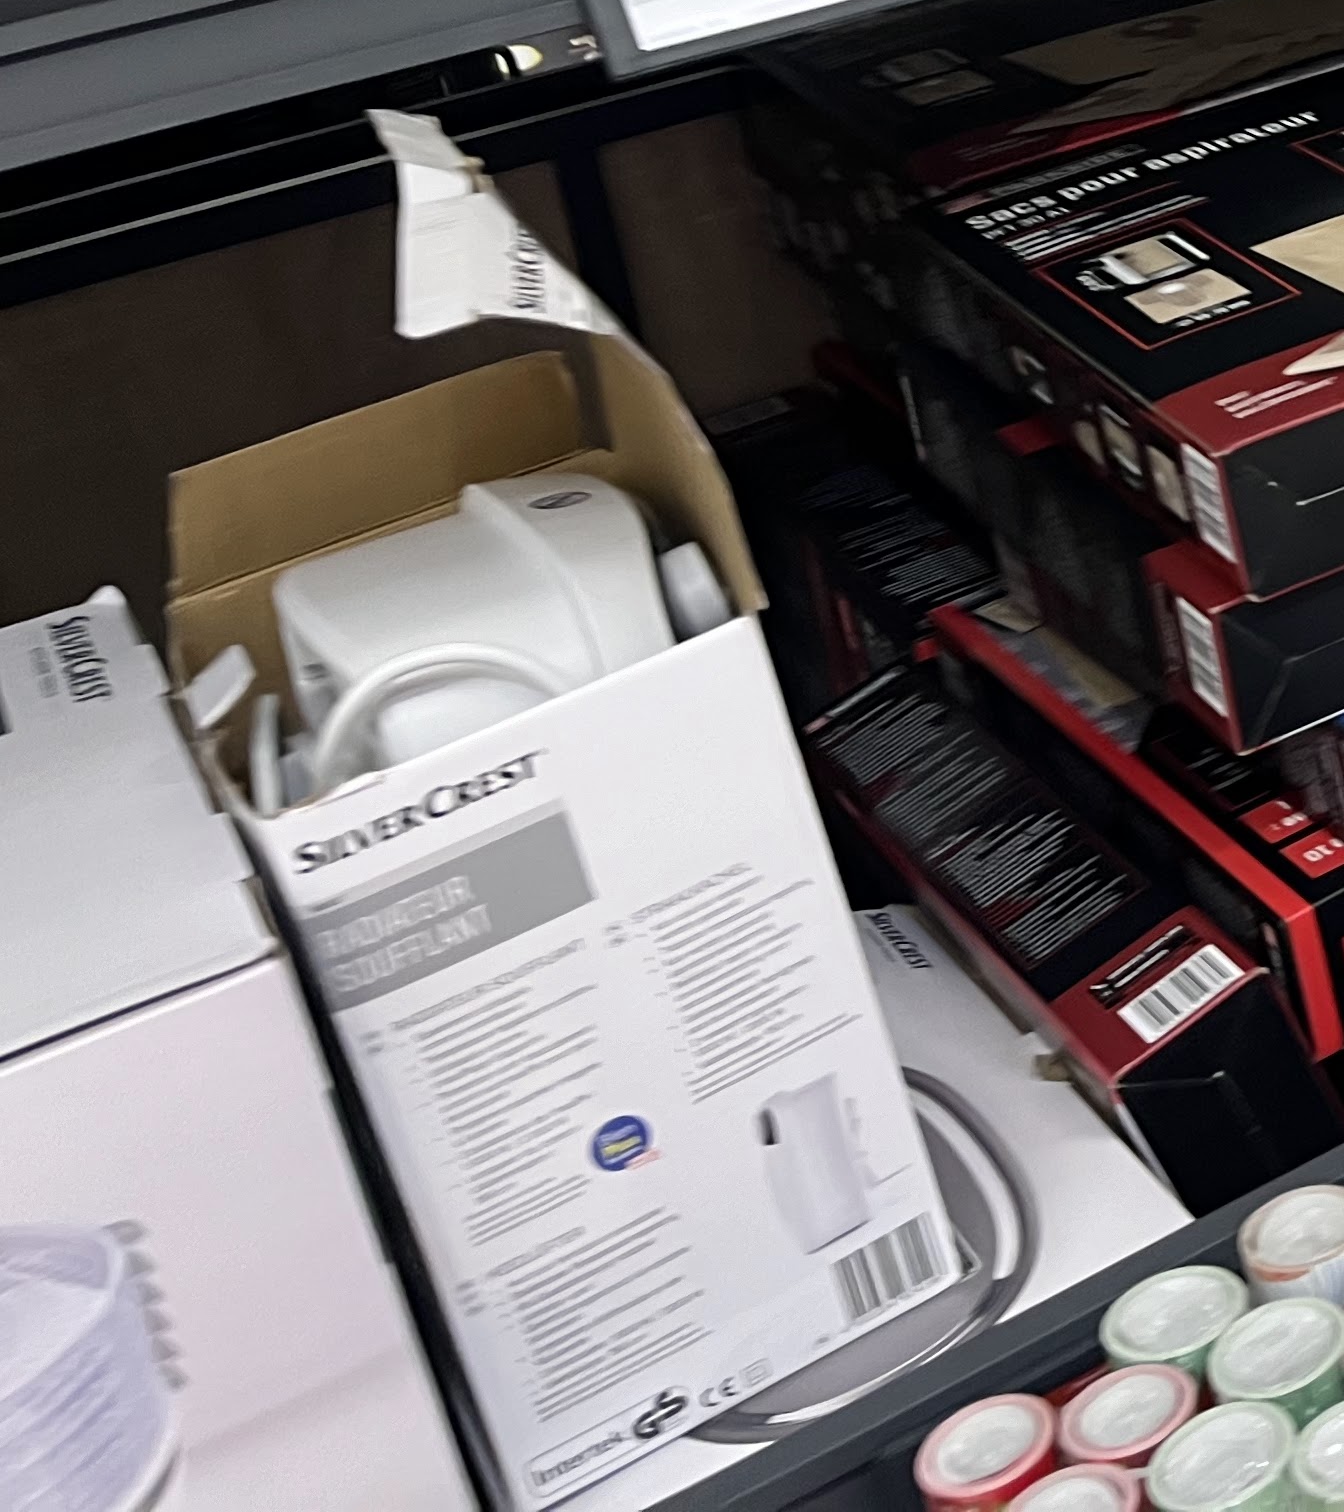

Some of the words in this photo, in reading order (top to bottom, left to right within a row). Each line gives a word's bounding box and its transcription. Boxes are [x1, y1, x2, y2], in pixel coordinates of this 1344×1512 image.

[965, 194, 1054, 234] Sacs
[1056, 163, 1141, 208] pour
[1141, 108, 1321, 175] aspirateur
[290, 748, 546, 876] SILVERCREST
[869, 909, 936, 970] SILVERCREST
[530, 1425, 627, 1487] Intertek
